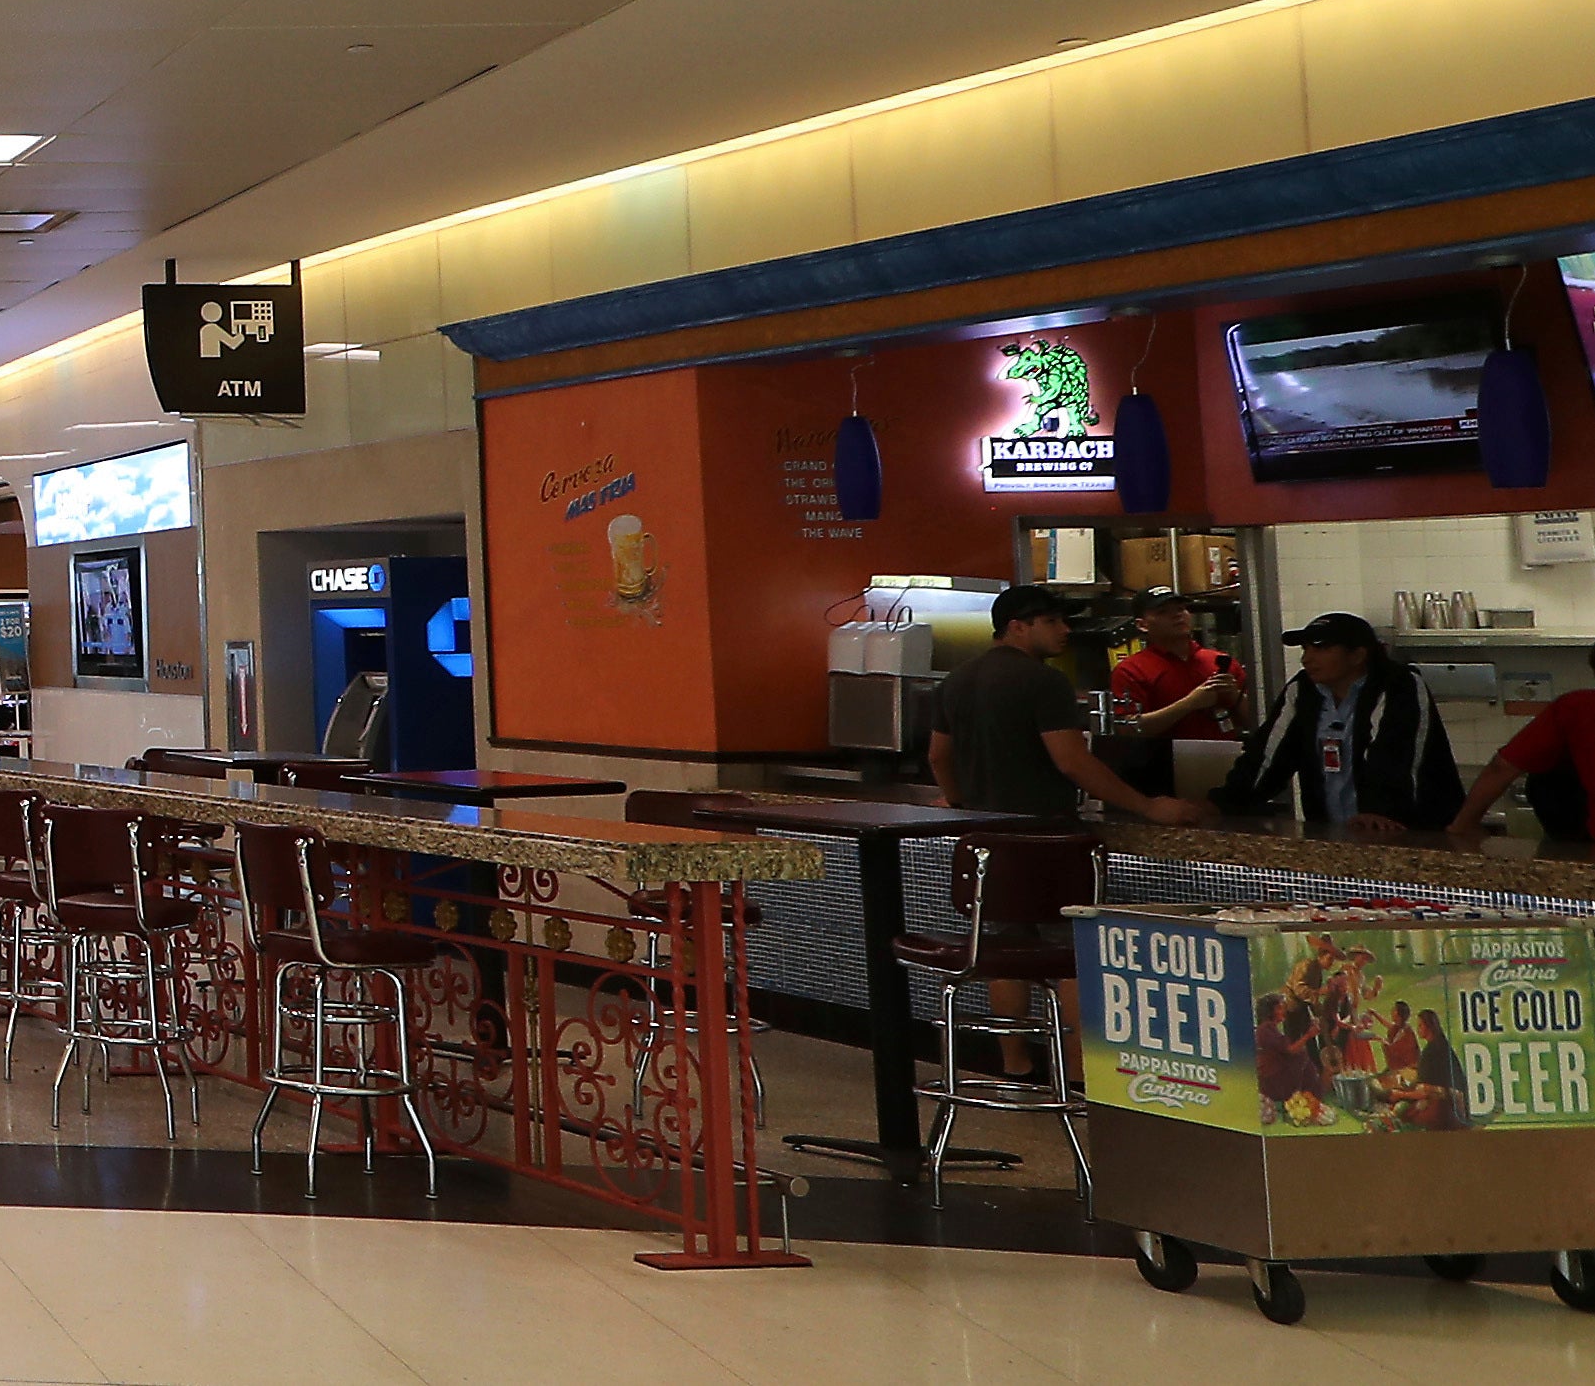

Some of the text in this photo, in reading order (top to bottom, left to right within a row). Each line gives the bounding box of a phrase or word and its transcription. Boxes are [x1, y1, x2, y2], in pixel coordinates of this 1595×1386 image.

[217, 380, 262, 397] ATM
[992, 440, 1114, 460] KARBACH
[783, 460, 827, 471] GRAND
[1016, 462, 1077, 472] BREWING
[784, 477, 806, 489] THE
[805, 510, 844, 522] MANG
[801, 527, 863, 539] THE WAVE
[310, 566, 369, 592] CHASE
[0, 625, 22, 638] $20
[1097, 924, 1225, 983] ICE COLD
[1479, 958, 1559, 993] Cantina
[1102, 972, 1230, 1062] BEER
[1460, 988, 1582, 1033] ICE COLD
[1464, 1040, 1590, 1115] BEER
[1127, 1072, 1211, 1109] Cantina
